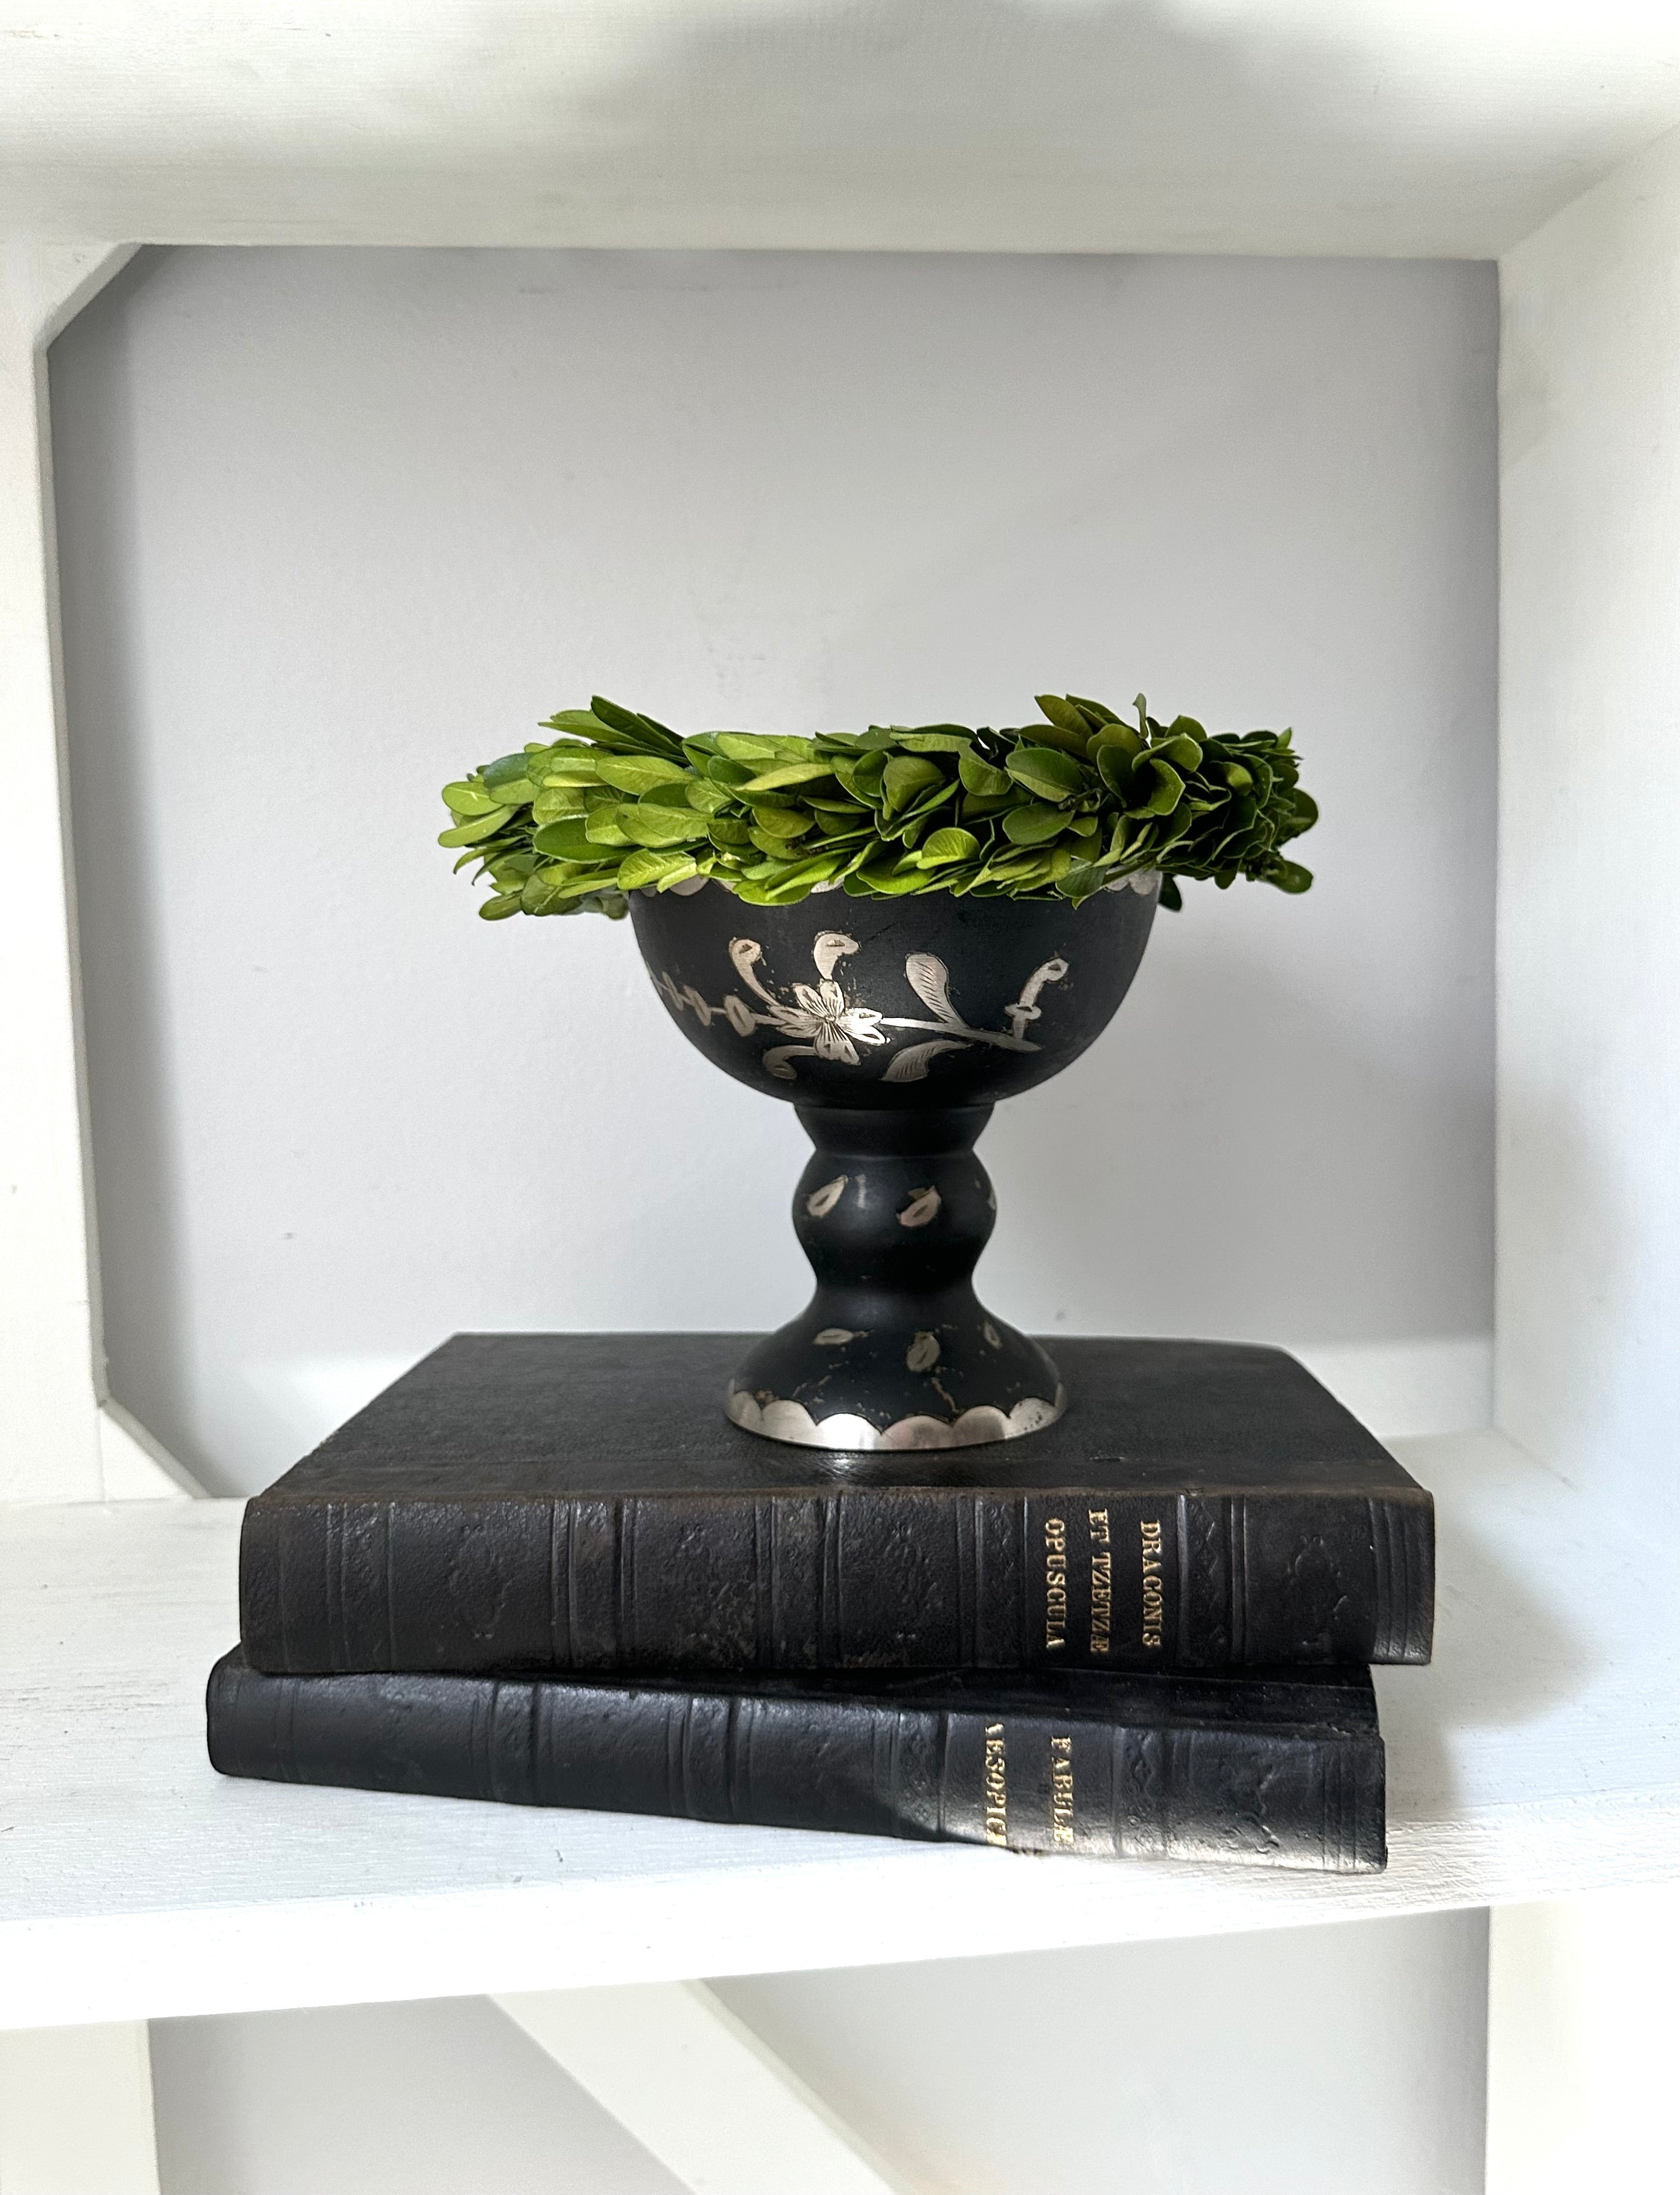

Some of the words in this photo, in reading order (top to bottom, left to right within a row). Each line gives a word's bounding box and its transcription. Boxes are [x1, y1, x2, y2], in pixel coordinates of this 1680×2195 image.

[1045, 1518, 1066, 1649] OPUSCULA
[1089, 1508, 1109, 1544] ET
[1141, 1520, 1161, 1646] DRACONIS
